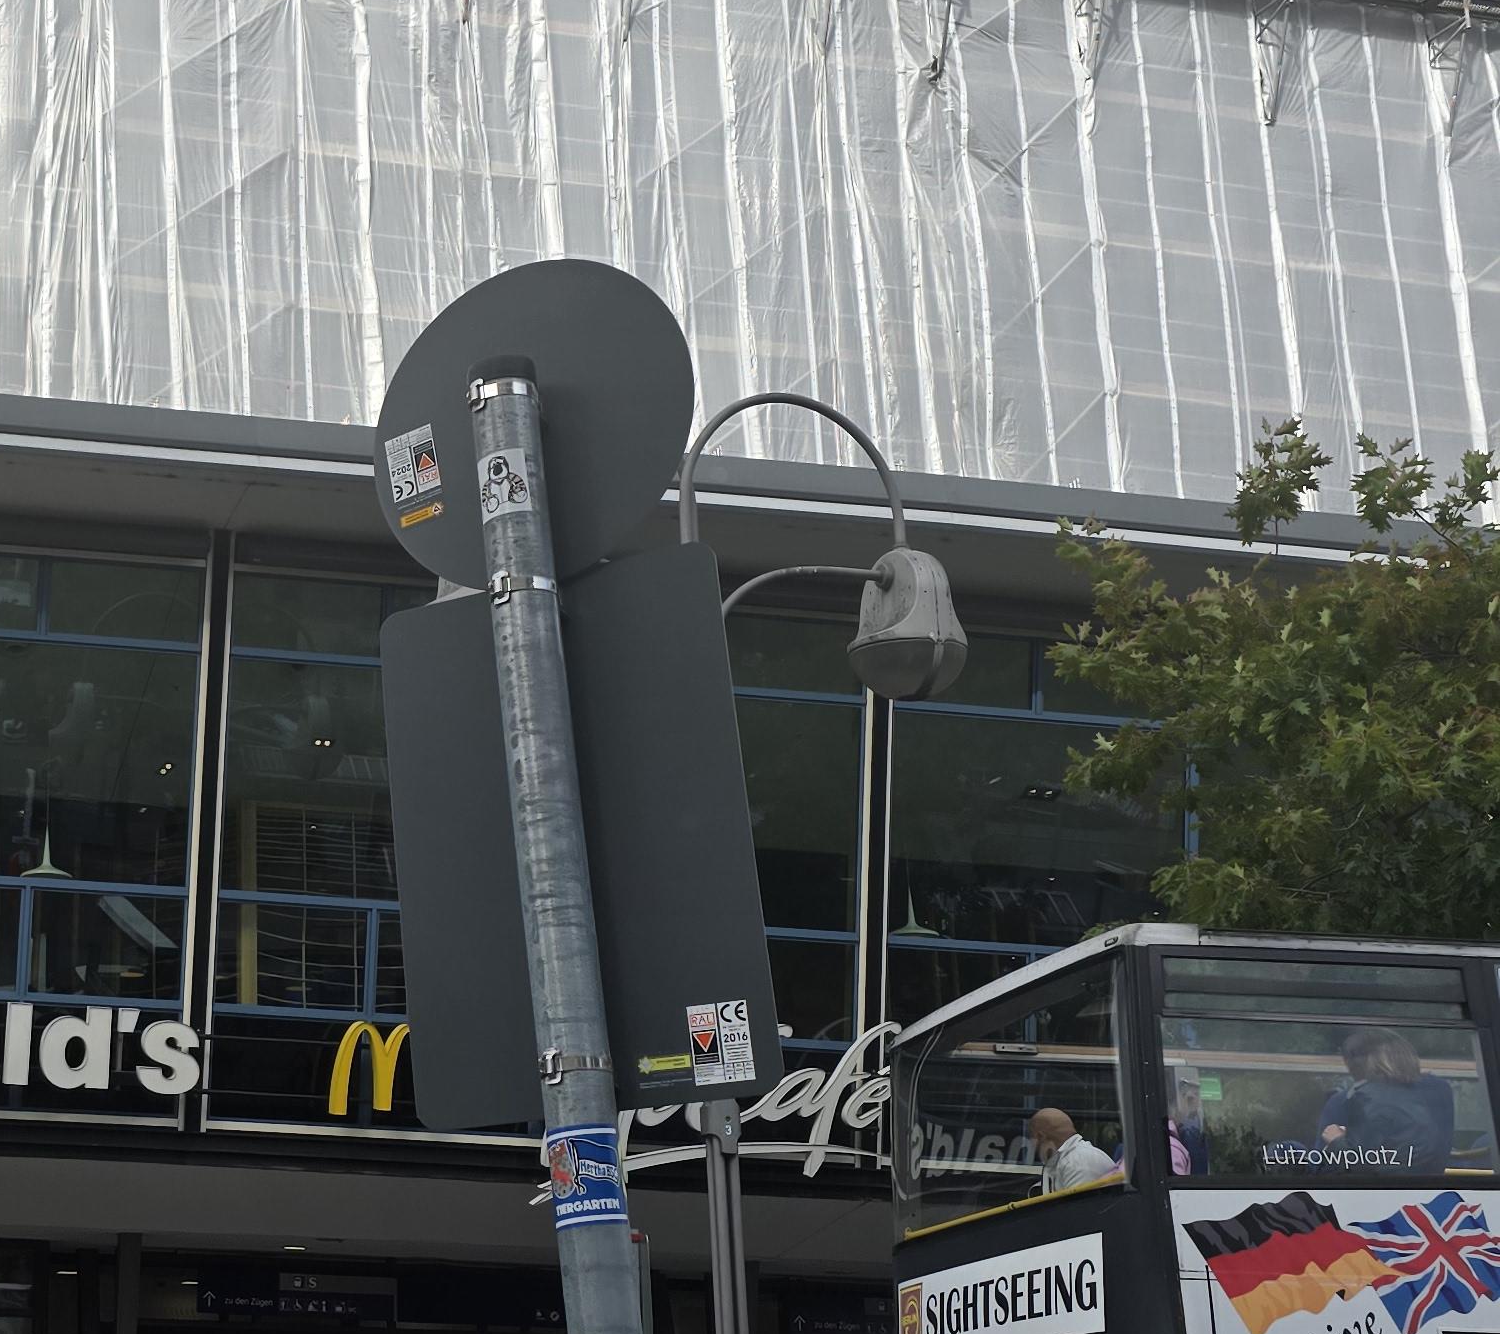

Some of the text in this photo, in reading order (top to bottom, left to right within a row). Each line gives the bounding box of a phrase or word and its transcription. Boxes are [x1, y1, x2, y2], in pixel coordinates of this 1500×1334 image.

[724, 1032, 748, 1043] 2016
[725, 1124, 732, 1136] 3
[1262, 1145, 1401, 1169] Lützowplatz
[580, 1161, 605, 1176] Hertha
[556, 1198, 620, 1216] TIERGARTEN
